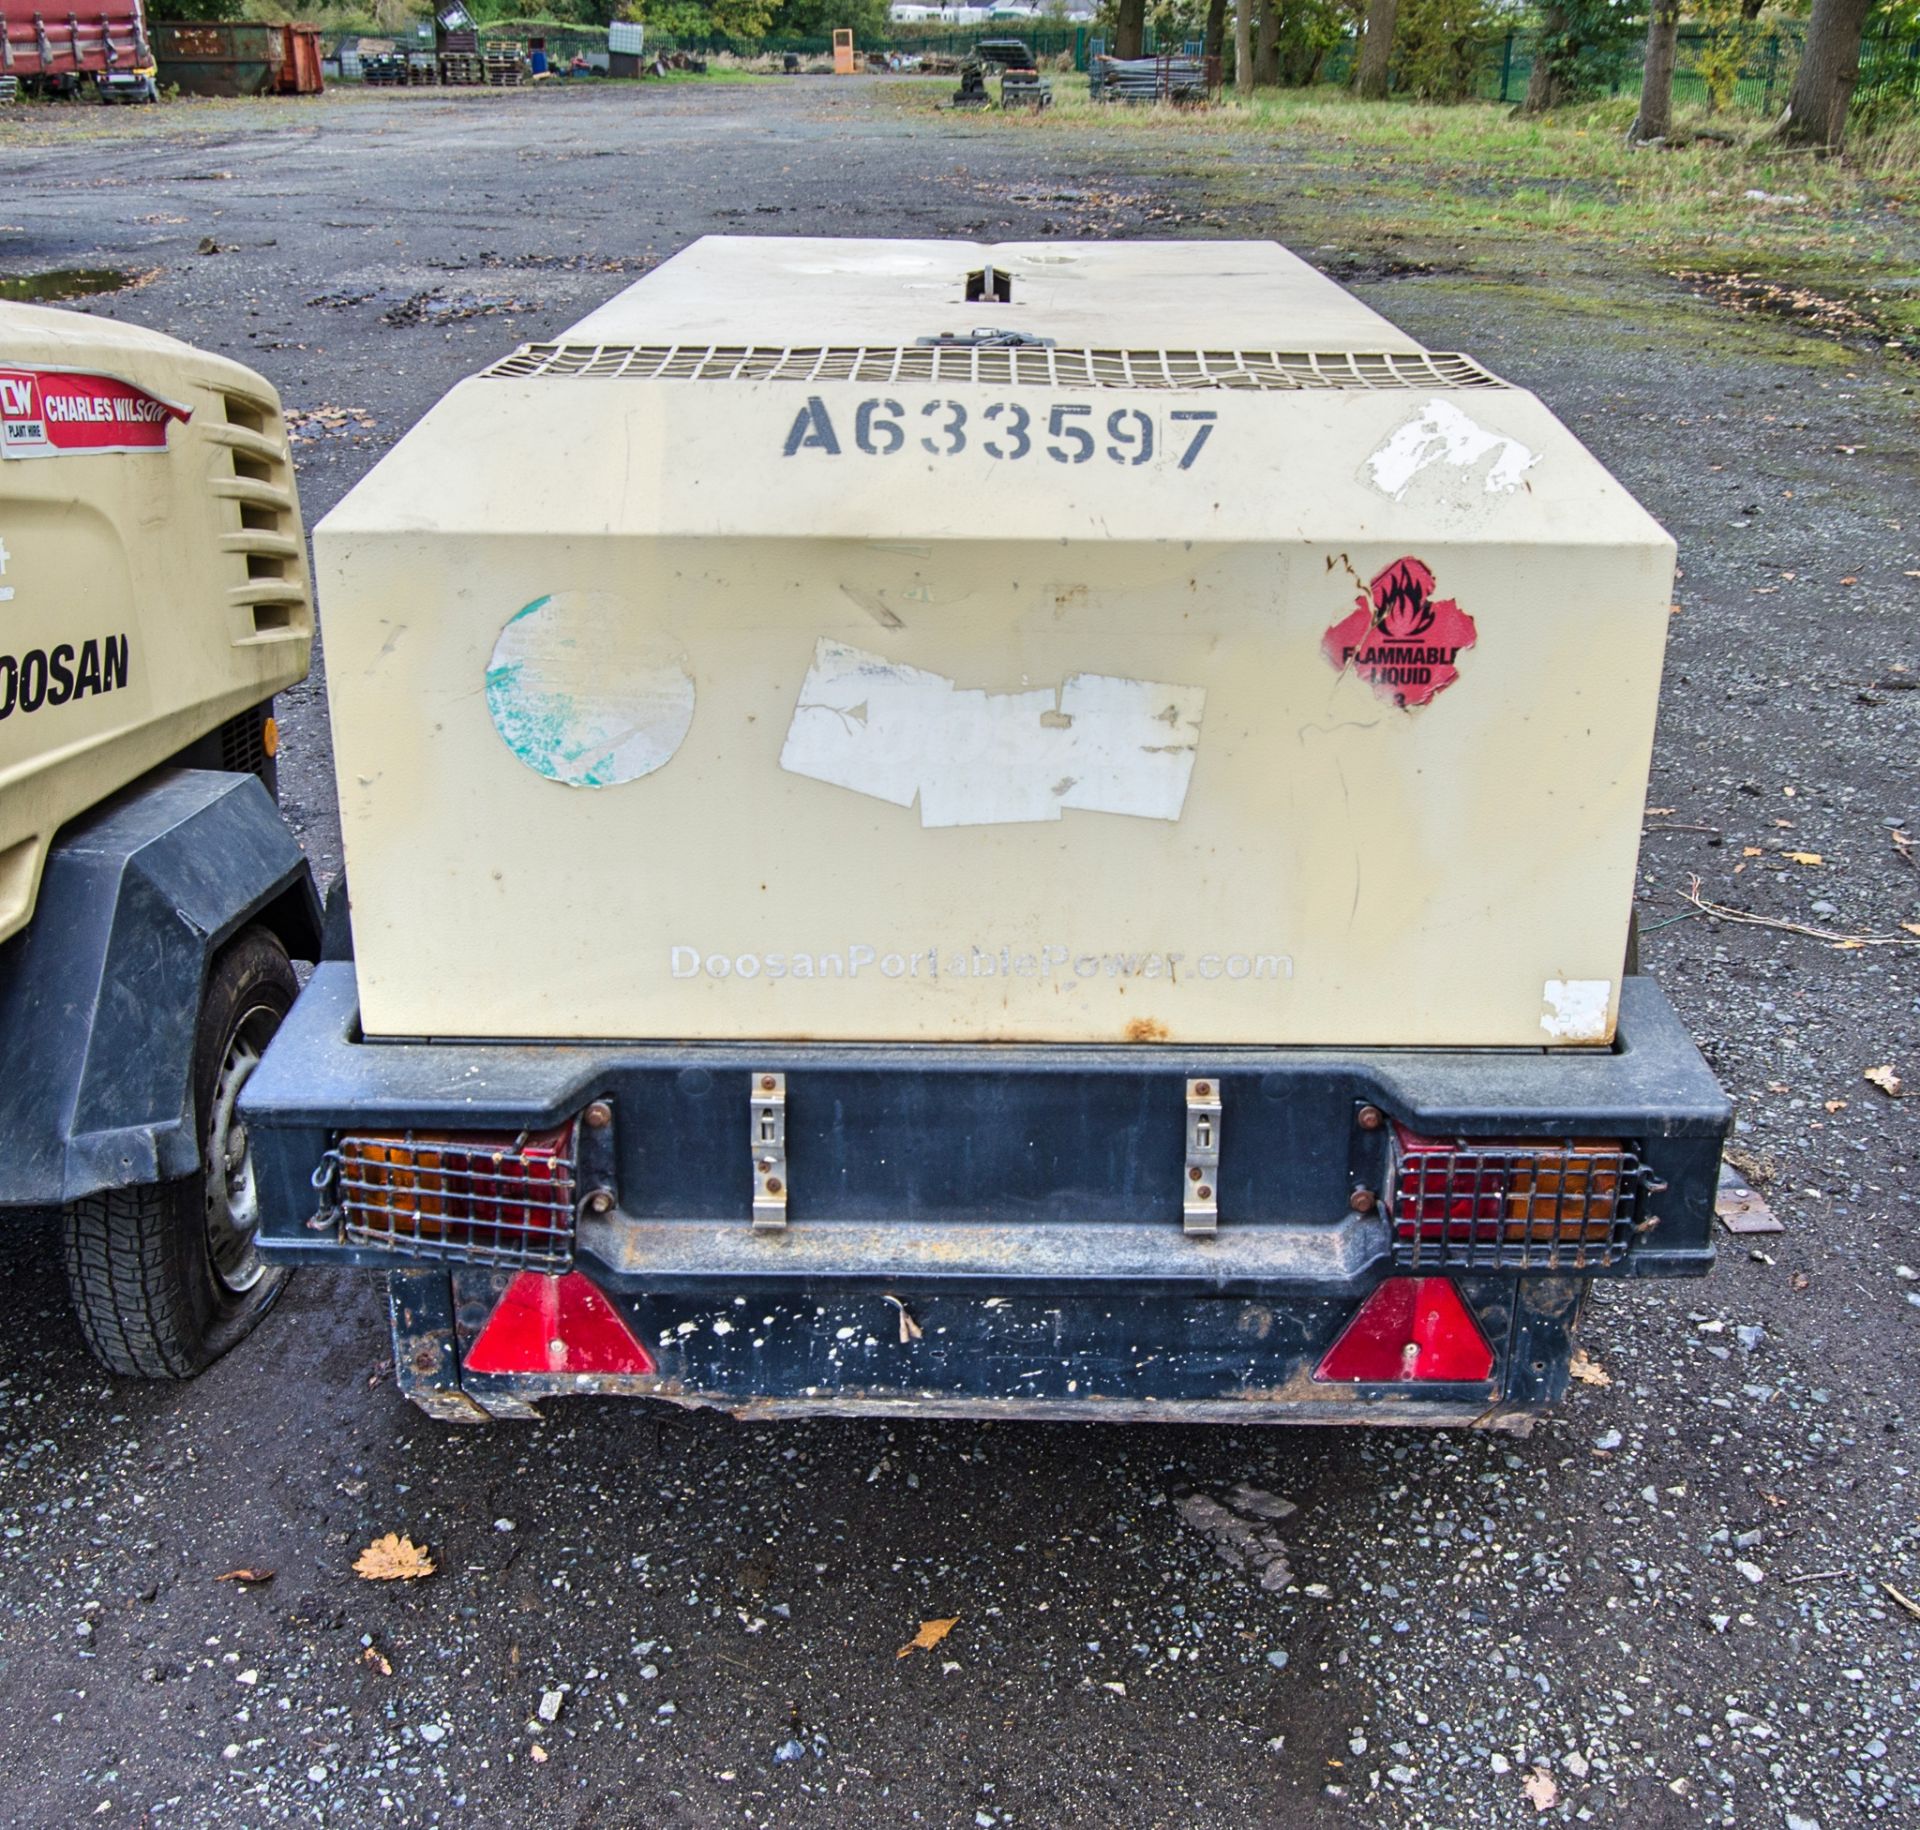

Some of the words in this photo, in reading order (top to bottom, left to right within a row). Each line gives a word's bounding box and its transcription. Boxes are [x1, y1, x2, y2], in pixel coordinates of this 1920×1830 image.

[45, 395, 113, 422] CHARLES
[112, 397, 166, 422] WILSON
[8, 424, 26, 438] PLANT
[27, 424, 42, 437] HIRE
[783, 396, 1218, 470] A633597
[1371, 667, 1431, 686] LIQUID
[671, 944, 1294, 979] DoosanPortablePower.com
